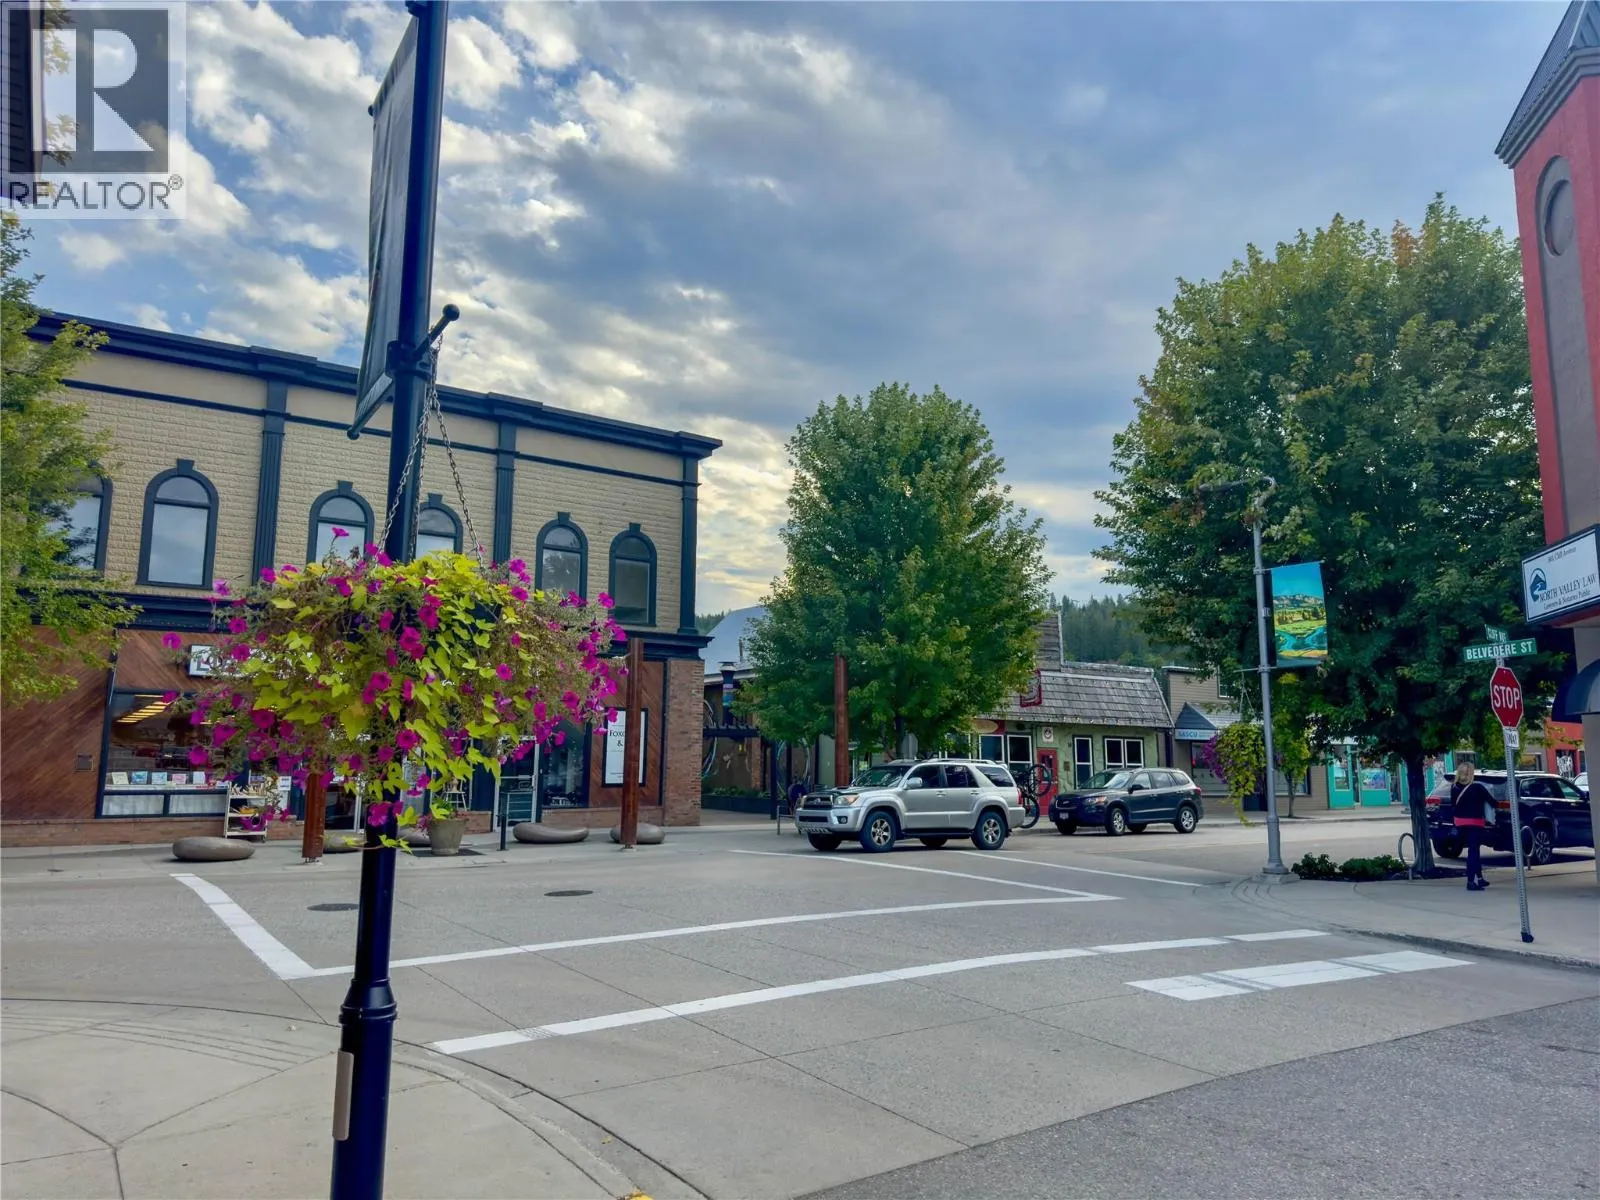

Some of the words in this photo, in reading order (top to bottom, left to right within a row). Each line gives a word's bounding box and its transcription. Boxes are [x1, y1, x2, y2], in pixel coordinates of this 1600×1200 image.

[1539, 587, 1558, 603] NORTH
[1558, 579, 1581, 596] VALLEY
[1582, 573, 1597, 588] LAW
[1578, 588, 1592, 599] Public
[1466, 643, 1517, 660] BELVEDERE
[1520, 641, 1533, 654] ST
[1493, 684, 1521, 710] STOP
